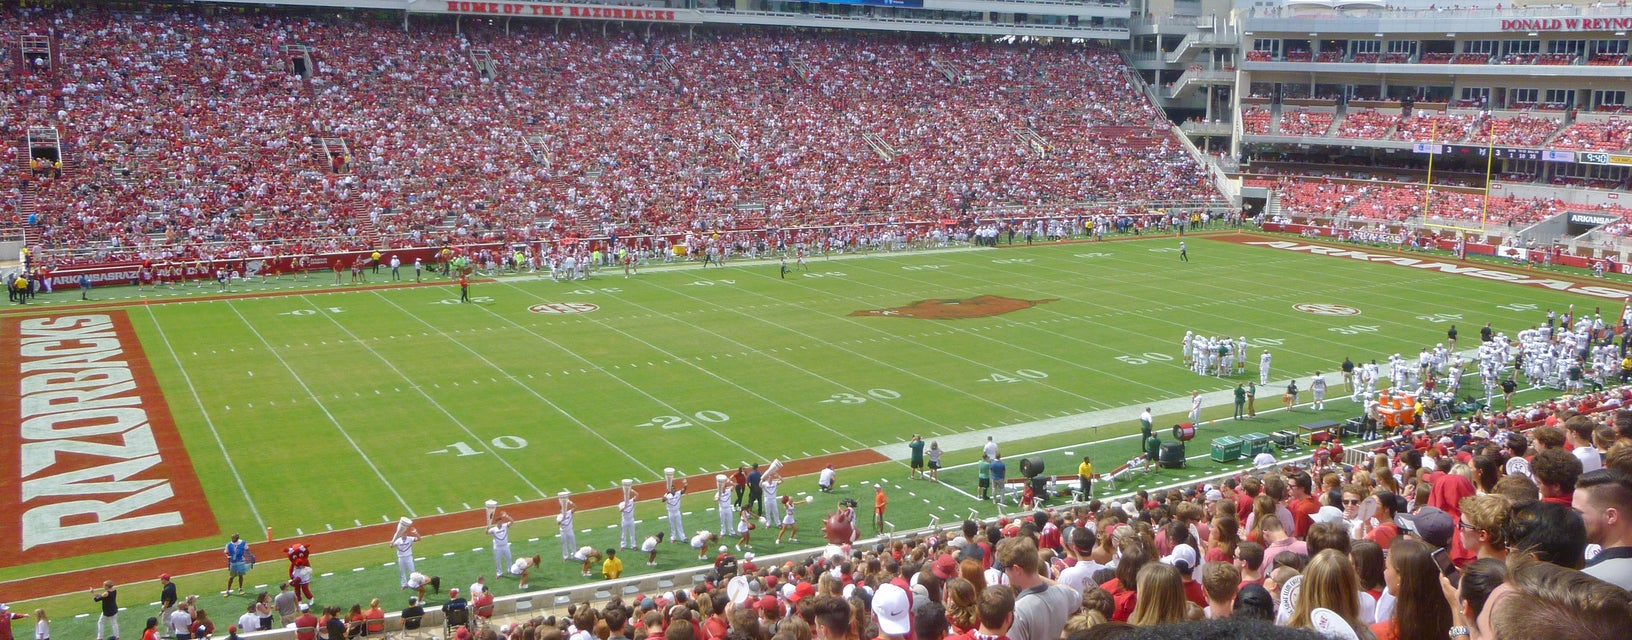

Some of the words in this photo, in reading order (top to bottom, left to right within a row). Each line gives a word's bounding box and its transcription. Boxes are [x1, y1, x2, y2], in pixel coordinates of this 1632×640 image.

[448, 1, 498, 13] HOME
[503, 3, 523, 14] OF
[530, 5, 563, 16] THE
[570, 6, 675, 20] RAZORBACKS
[1501, 19, 1562, 30] DONALD
[1566, 19, 1578, 30] W
[1587, 153, 1607, 162] 9:40
[1244, 241, 1632, 299] ARKANSAS
[1114, 352, 1174, 365] 50
[988, 369, 1049, 383] 40
[830, 388, 902, 404] 30
[650, 410, 730, 430] 20
[20, 314, 184, 552] RAZORBACKS
[446, 435, 529, 457] 10
